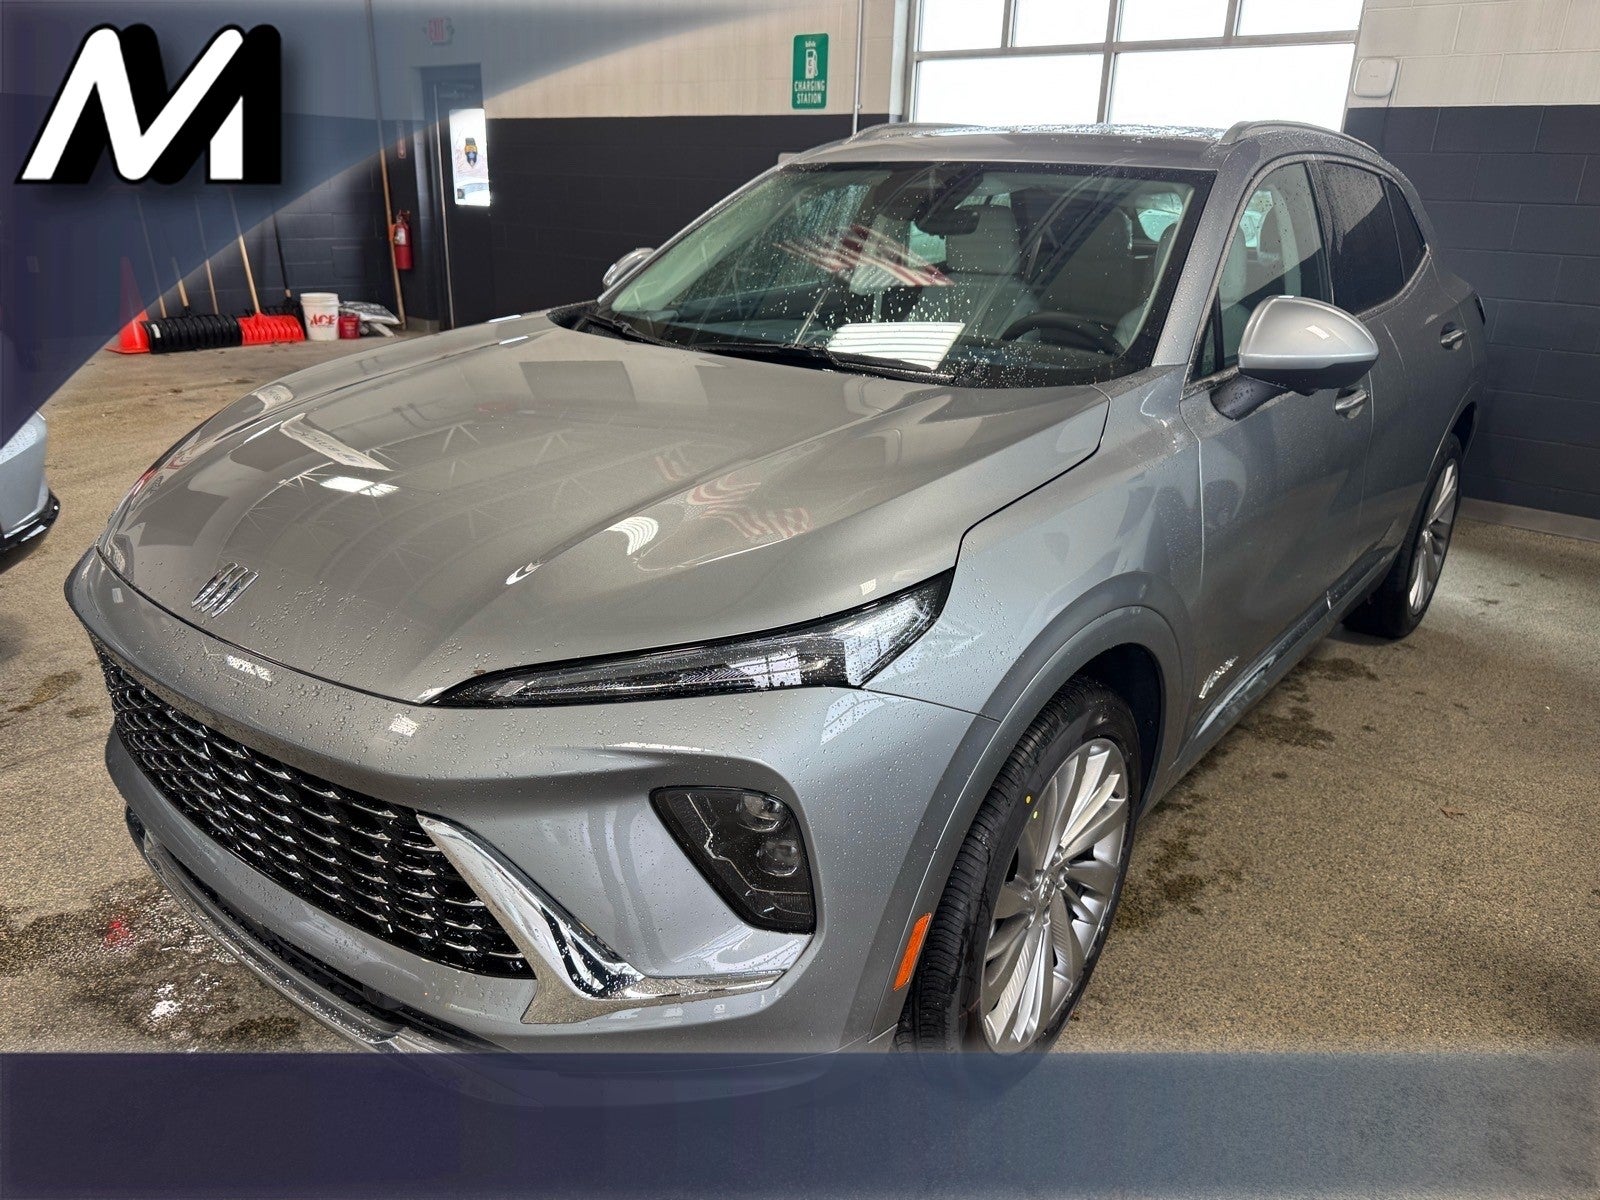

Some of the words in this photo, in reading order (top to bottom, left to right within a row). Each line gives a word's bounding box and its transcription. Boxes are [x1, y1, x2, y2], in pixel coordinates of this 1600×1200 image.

[794, 80, 825, 91] CHARGING
[796, 92, 821, 104] STATION
[310, 314, 335, 325] ACE
